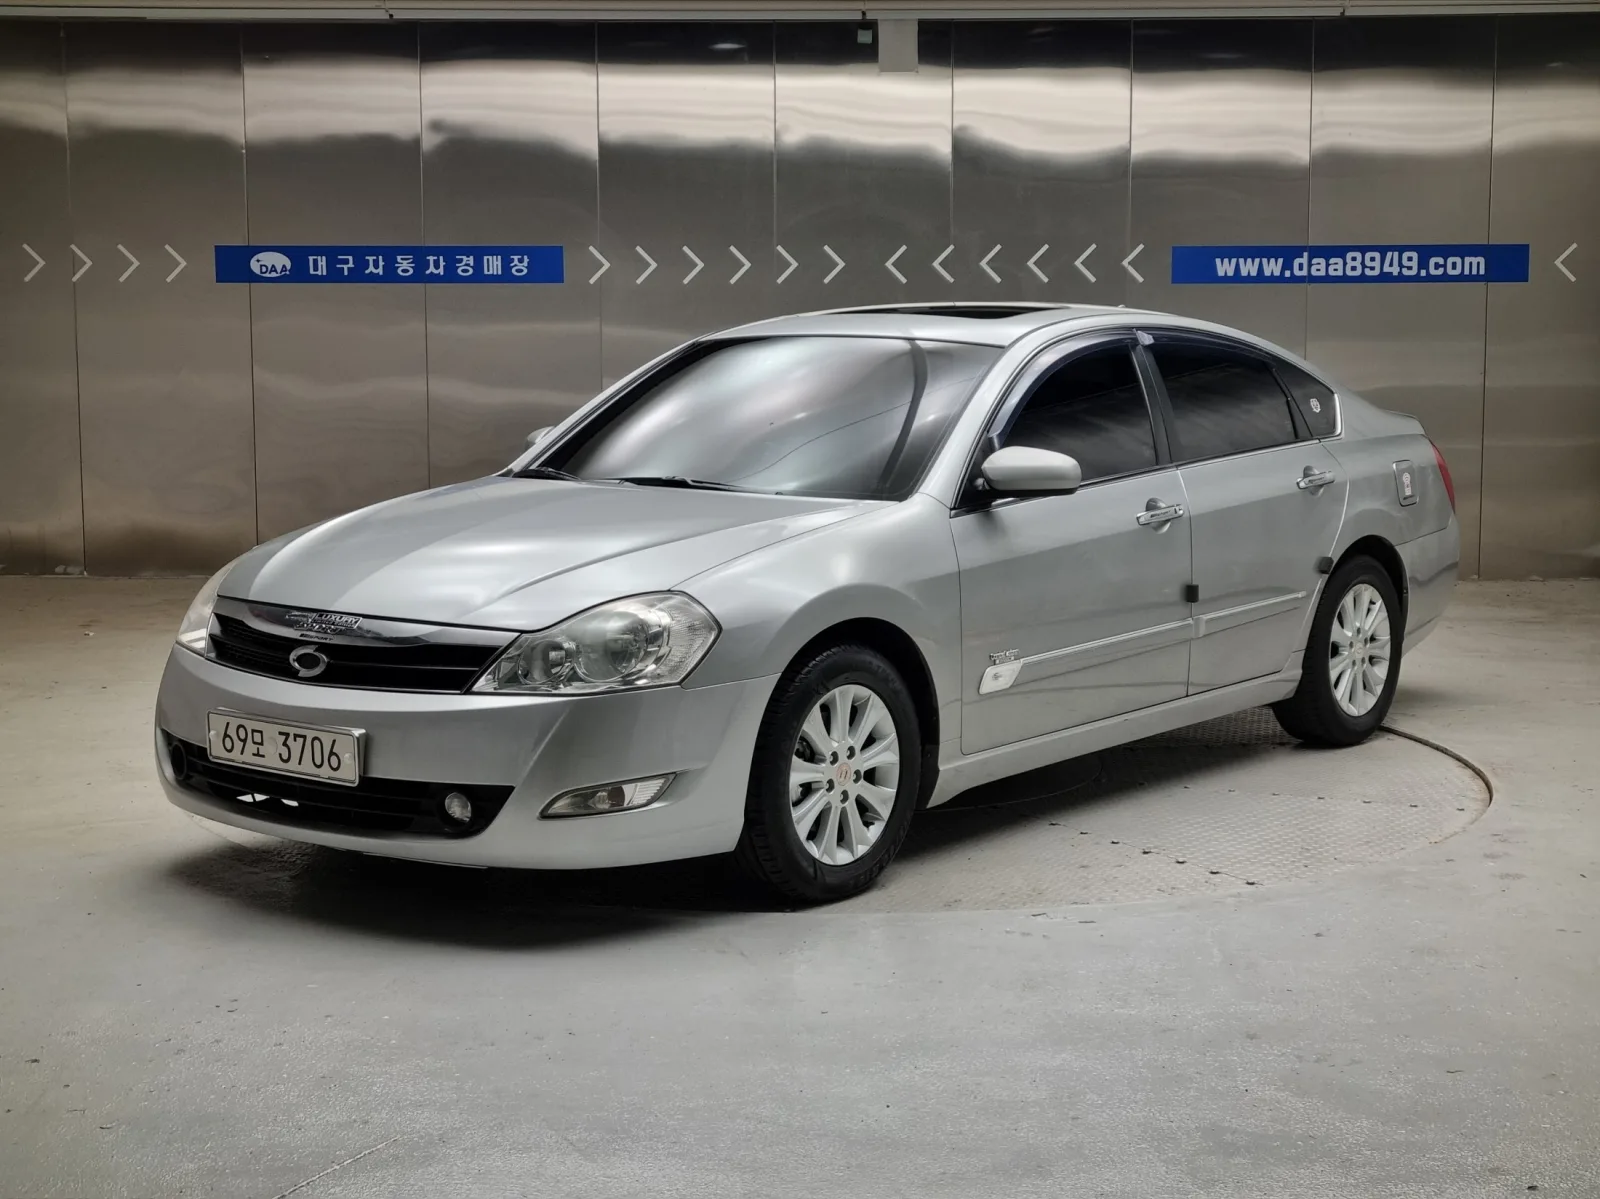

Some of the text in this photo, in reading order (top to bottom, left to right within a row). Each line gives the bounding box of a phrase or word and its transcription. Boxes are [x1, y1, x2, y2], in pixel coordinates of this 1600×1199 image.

[260, 264, 290, 275] DAA
[1215, 251, 1486, 278] www.daa8949.com
[315, 613, 359, 624] LUXURY
[222, 722, 342, 772] 69모 3706
